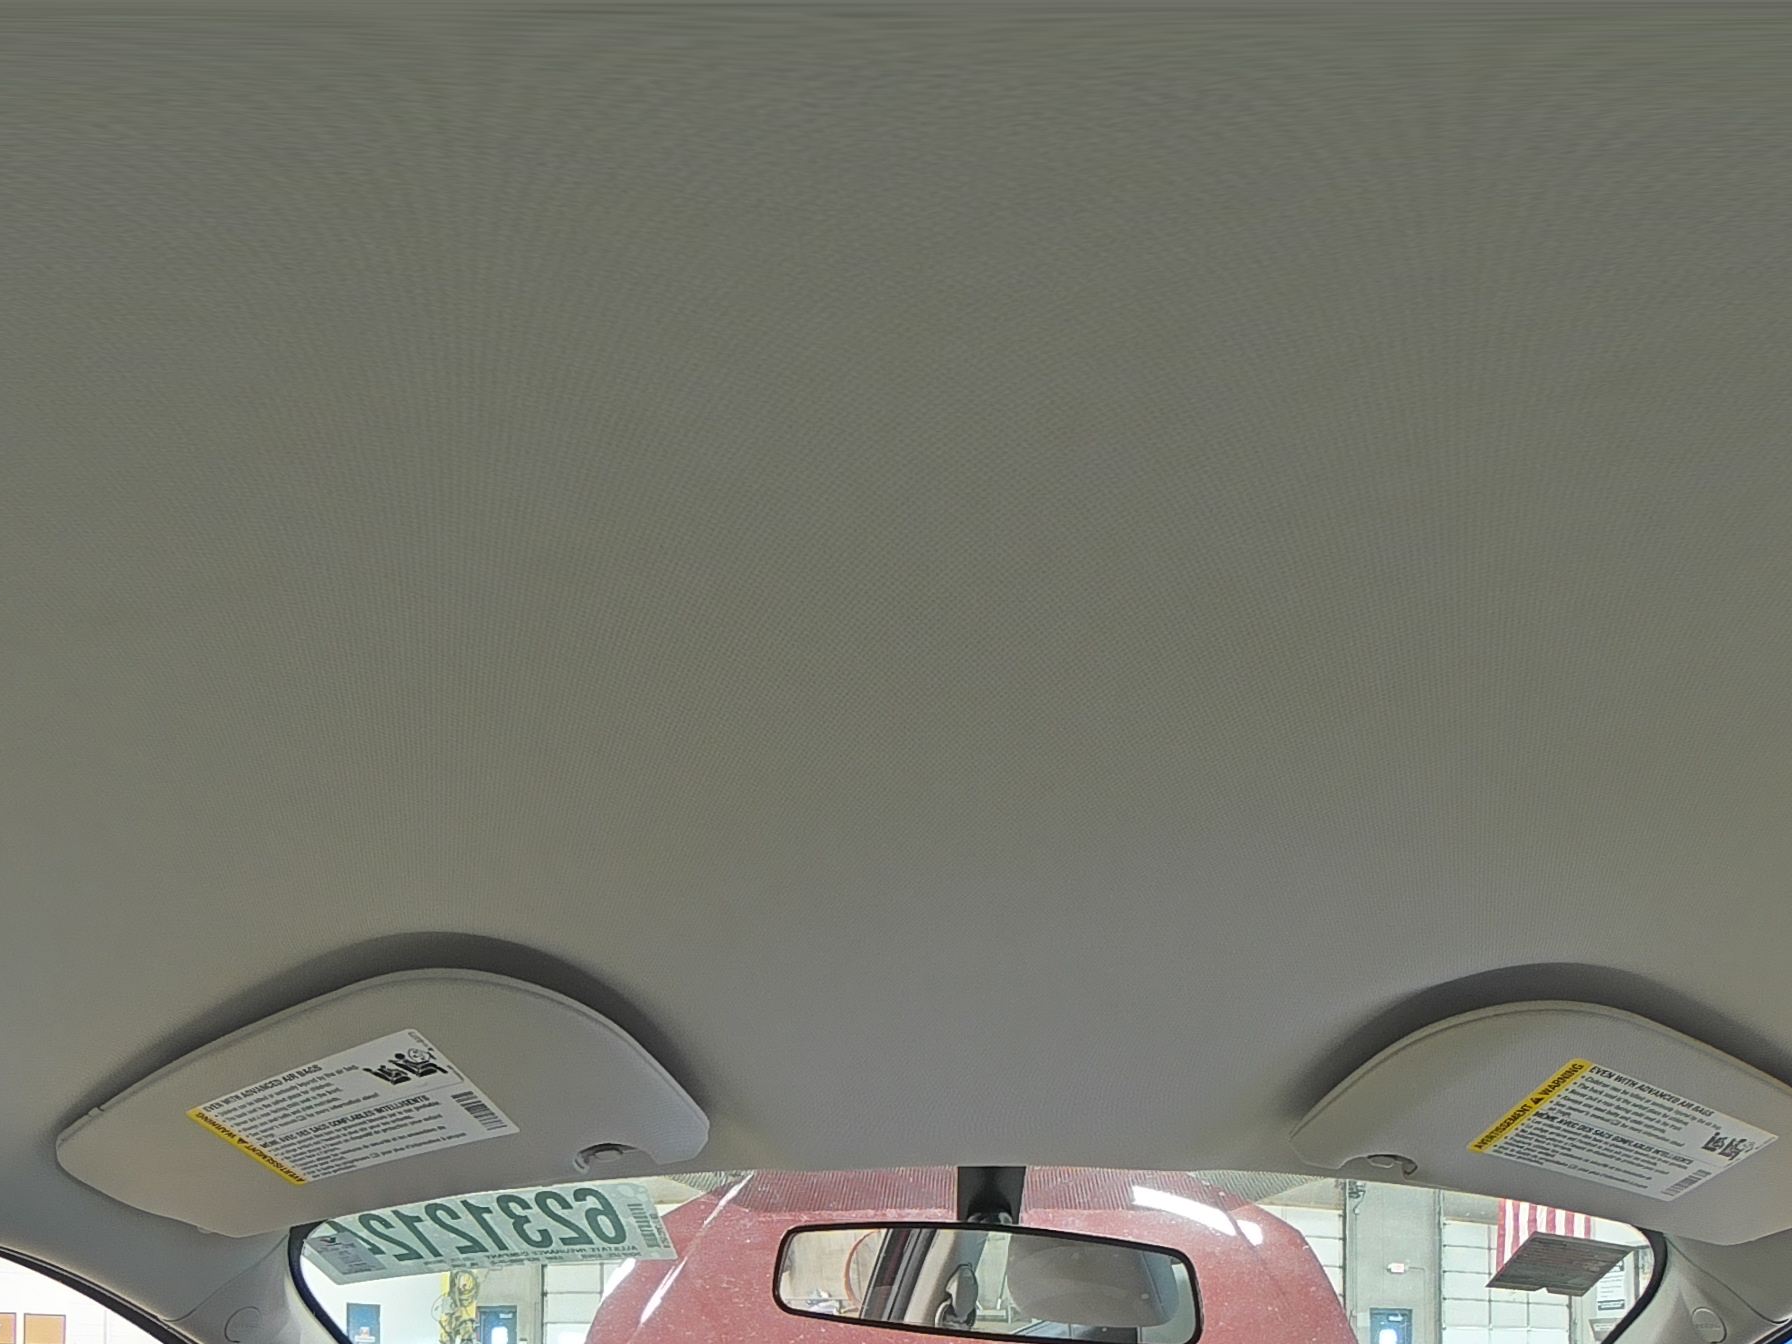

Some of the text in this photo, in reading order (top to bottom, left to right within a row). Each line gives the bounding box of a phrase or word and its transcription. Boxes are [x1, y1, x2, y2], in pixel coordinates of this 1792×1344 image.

[241, 1079, 283, 1098] ADVANCED
[281, 1073, 299, 1083] AIR
[295, 1064, 323, 1077] BAGS
[1589, 1066, 1616, 1079] EVEN
[1613, 1075, 1639, 1088] WITH
[1635, 1084, 1680, 1104] ADVANCED
[1475, 1063, 1584, 1149] AVERTISSEMENT WARNING
[195, 1112, 236, 1139] WARNING
[245, 1145, 305, 1182] AVERTISSEMENT
